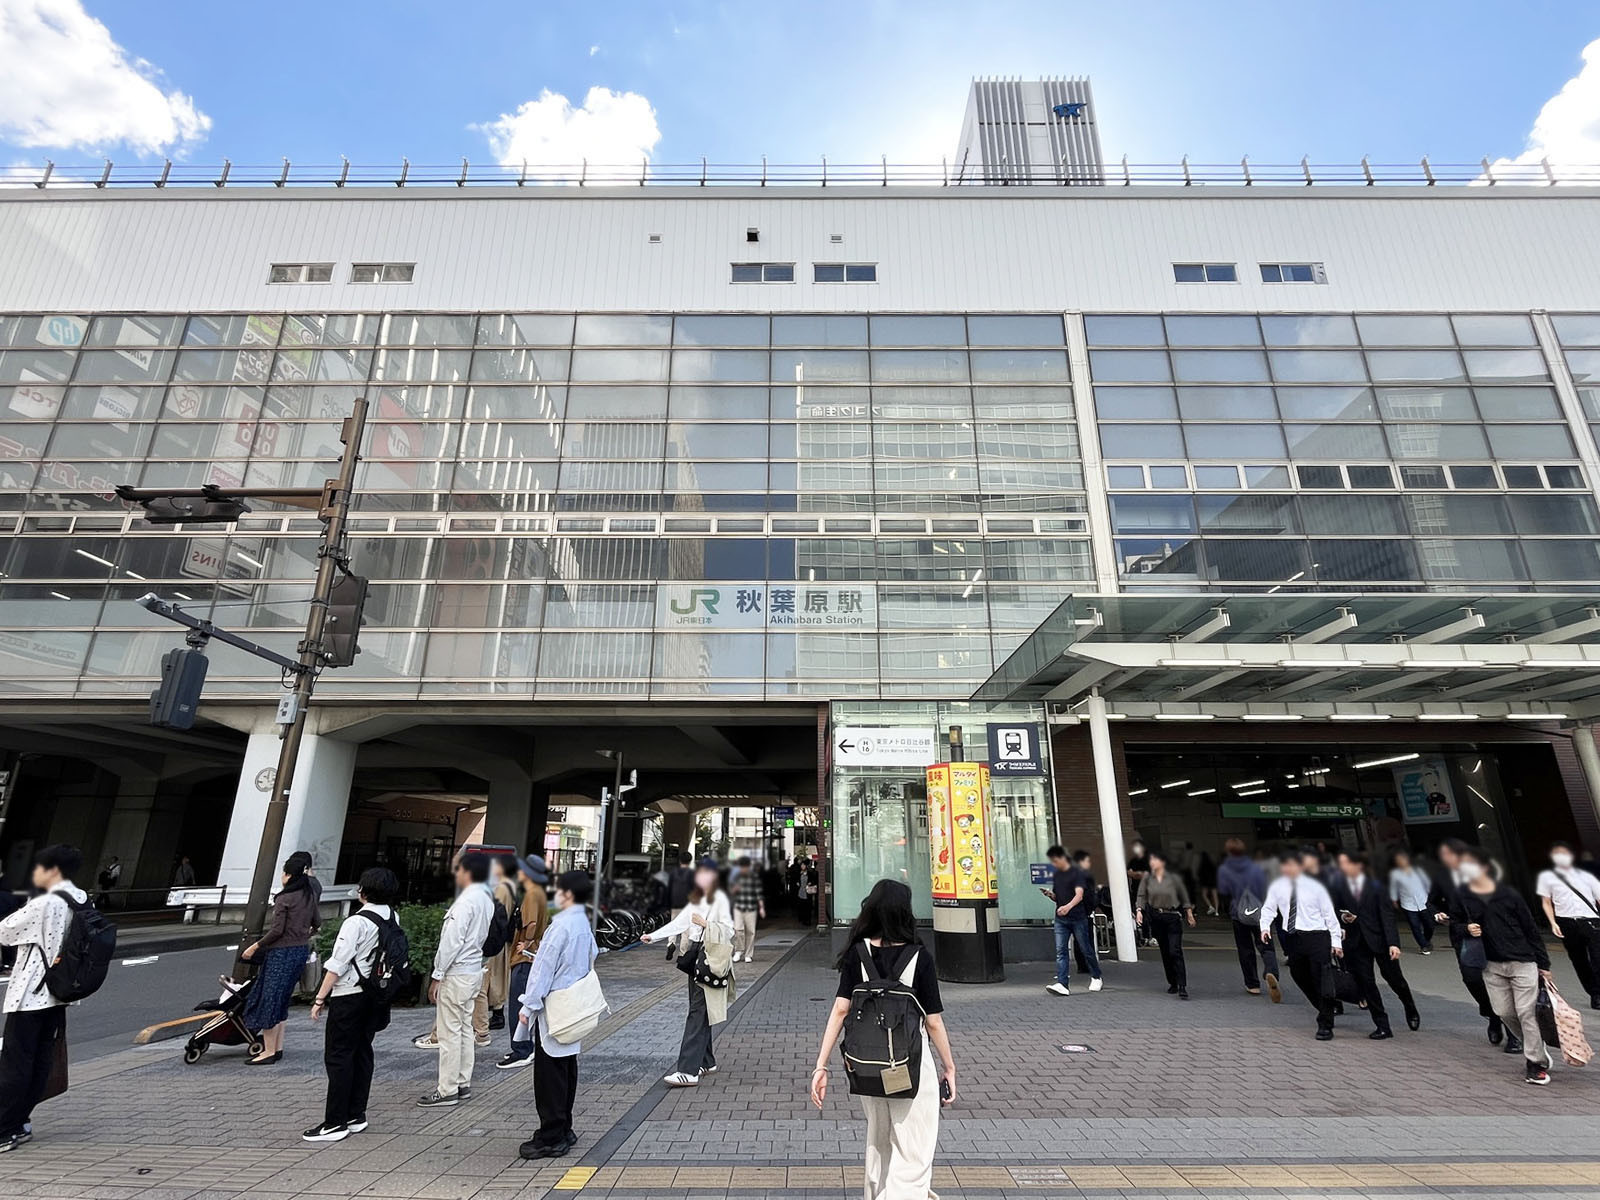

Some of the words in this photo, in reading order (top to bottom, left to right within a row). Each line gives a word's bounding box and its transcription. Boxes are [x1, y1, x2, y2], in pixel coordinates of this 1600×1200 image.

[670, 588, 721, 615] JR
[736, 589, 864, 614] 秋葉原駅
[675, 616, 713, 626] JR東日本
[769, 615, 823, 626] Akihabara
[825, 615, 864, 626] Station
